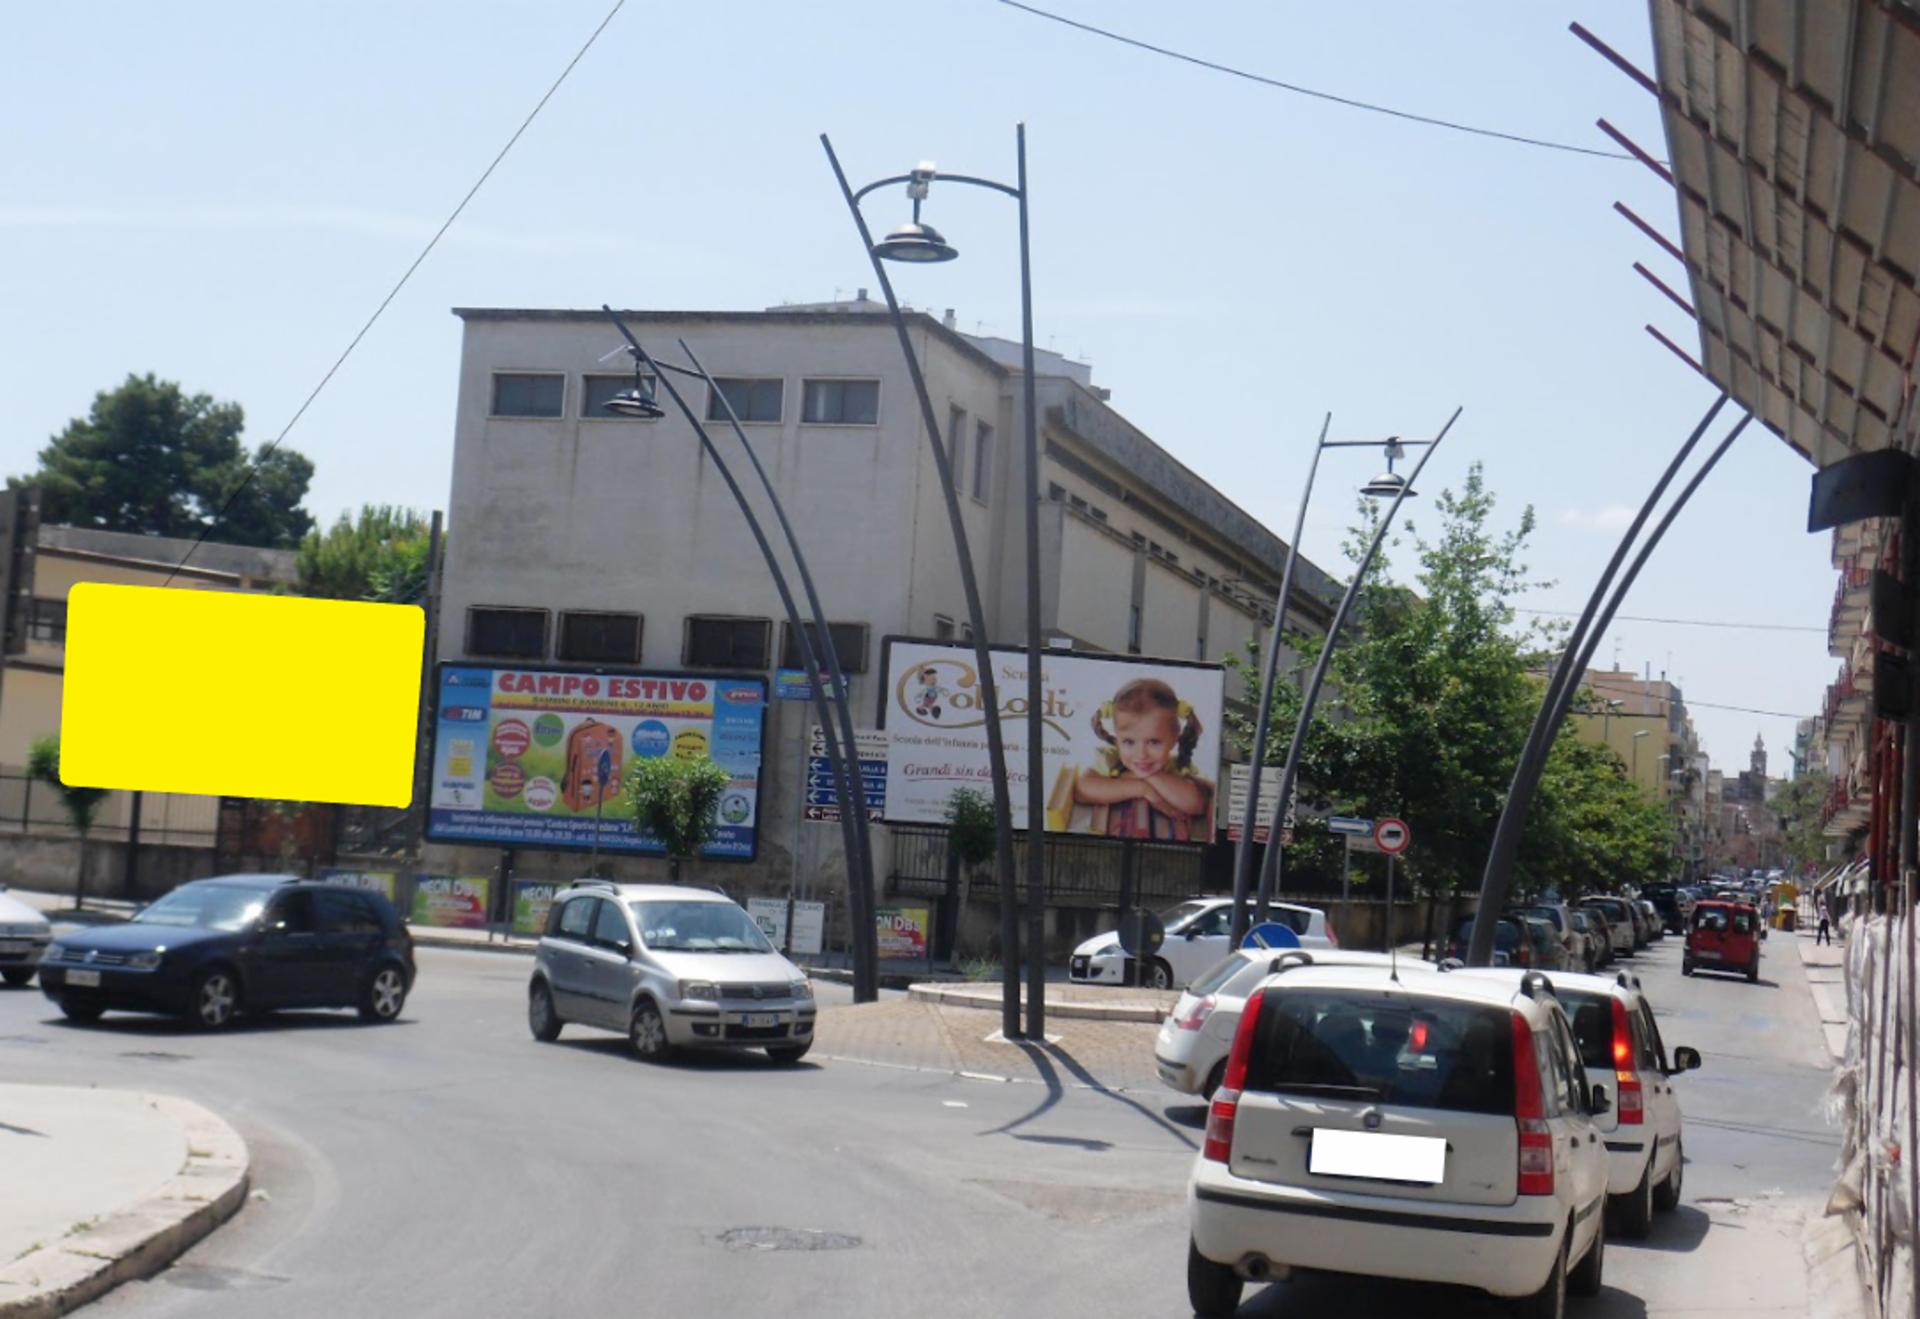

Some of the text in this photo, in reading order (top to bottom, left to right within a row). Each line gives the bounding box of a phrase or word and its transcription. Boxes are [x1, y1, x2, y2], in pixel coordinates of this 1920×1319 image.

[498, 672, 600, 697] CAMPO
[608, 678, 707, 702] ESTIVO
[461, 708, 483, 720] TIM
[893, 734, 922, 745] Scuola
[903, 763, 951, 777] Grandi
[954, 763, 974, 777] sin
[419, 878, 450, 894] NEON
[521, 886, 553, 902] NEON
